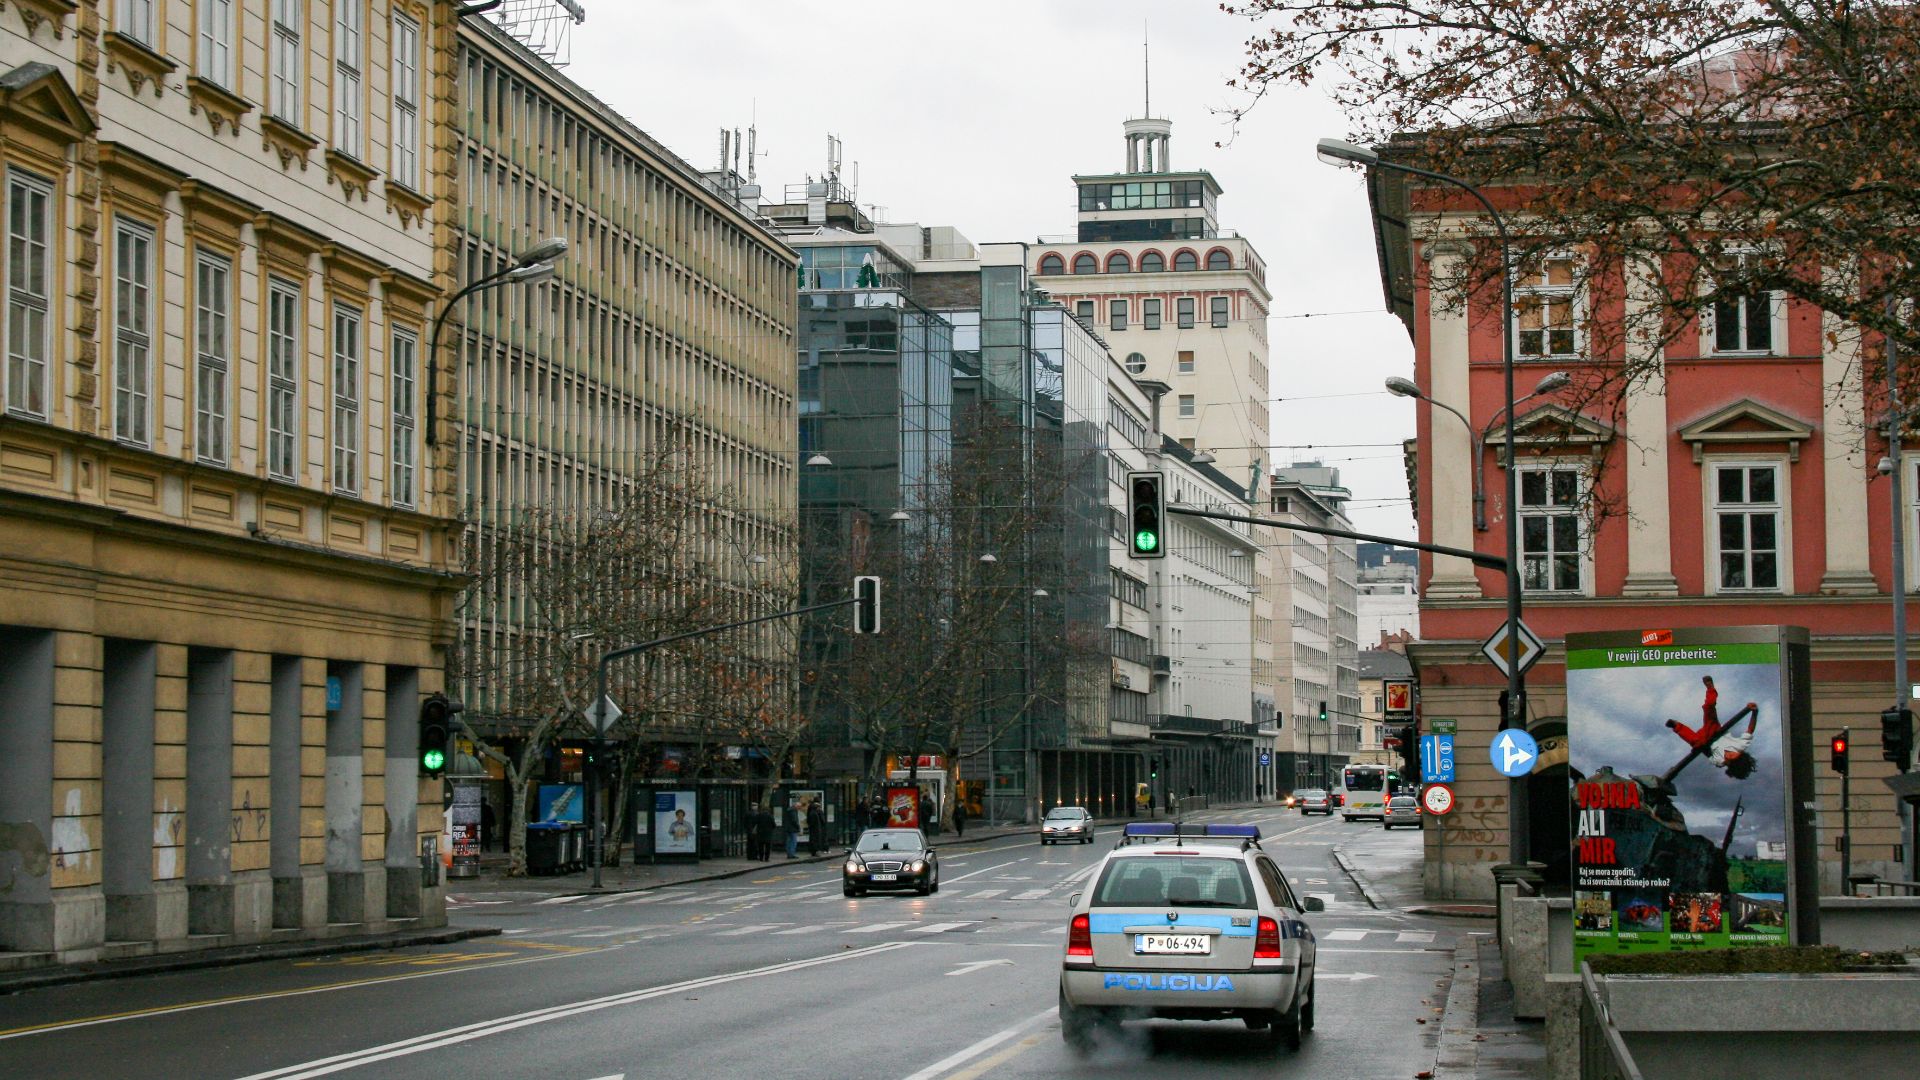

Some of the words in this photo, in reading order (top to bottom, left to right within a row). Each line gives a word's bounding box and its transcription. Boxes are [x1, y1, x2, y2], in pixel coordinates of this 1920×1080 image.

[1607, 651, 1613, 661] V
[1616, 650, 1640, 663] reviji
[1642, 649, 1661, 661] GEO
[1663, 648, 1717, 662] preberite:
[1577, 782, 1640, 809] VOJNA
[1578, 809, 1606, 836] ALI
[1580, 837, 1617, 864] MIR
[1579, 867, 1588, 877] Kaj
[1611, 867, 1636, 877] zgoditi,
[1587, 878, 1591, 886] si
[1592, 877, 1622, 886] sovražniki
[1623, 878, 1649, 888] stisnejo
[1650, 878, 1670, 887] roko?
[1148, 937, 1154, 948] P
[1103, 974, 1235, 992] POLICIJA
